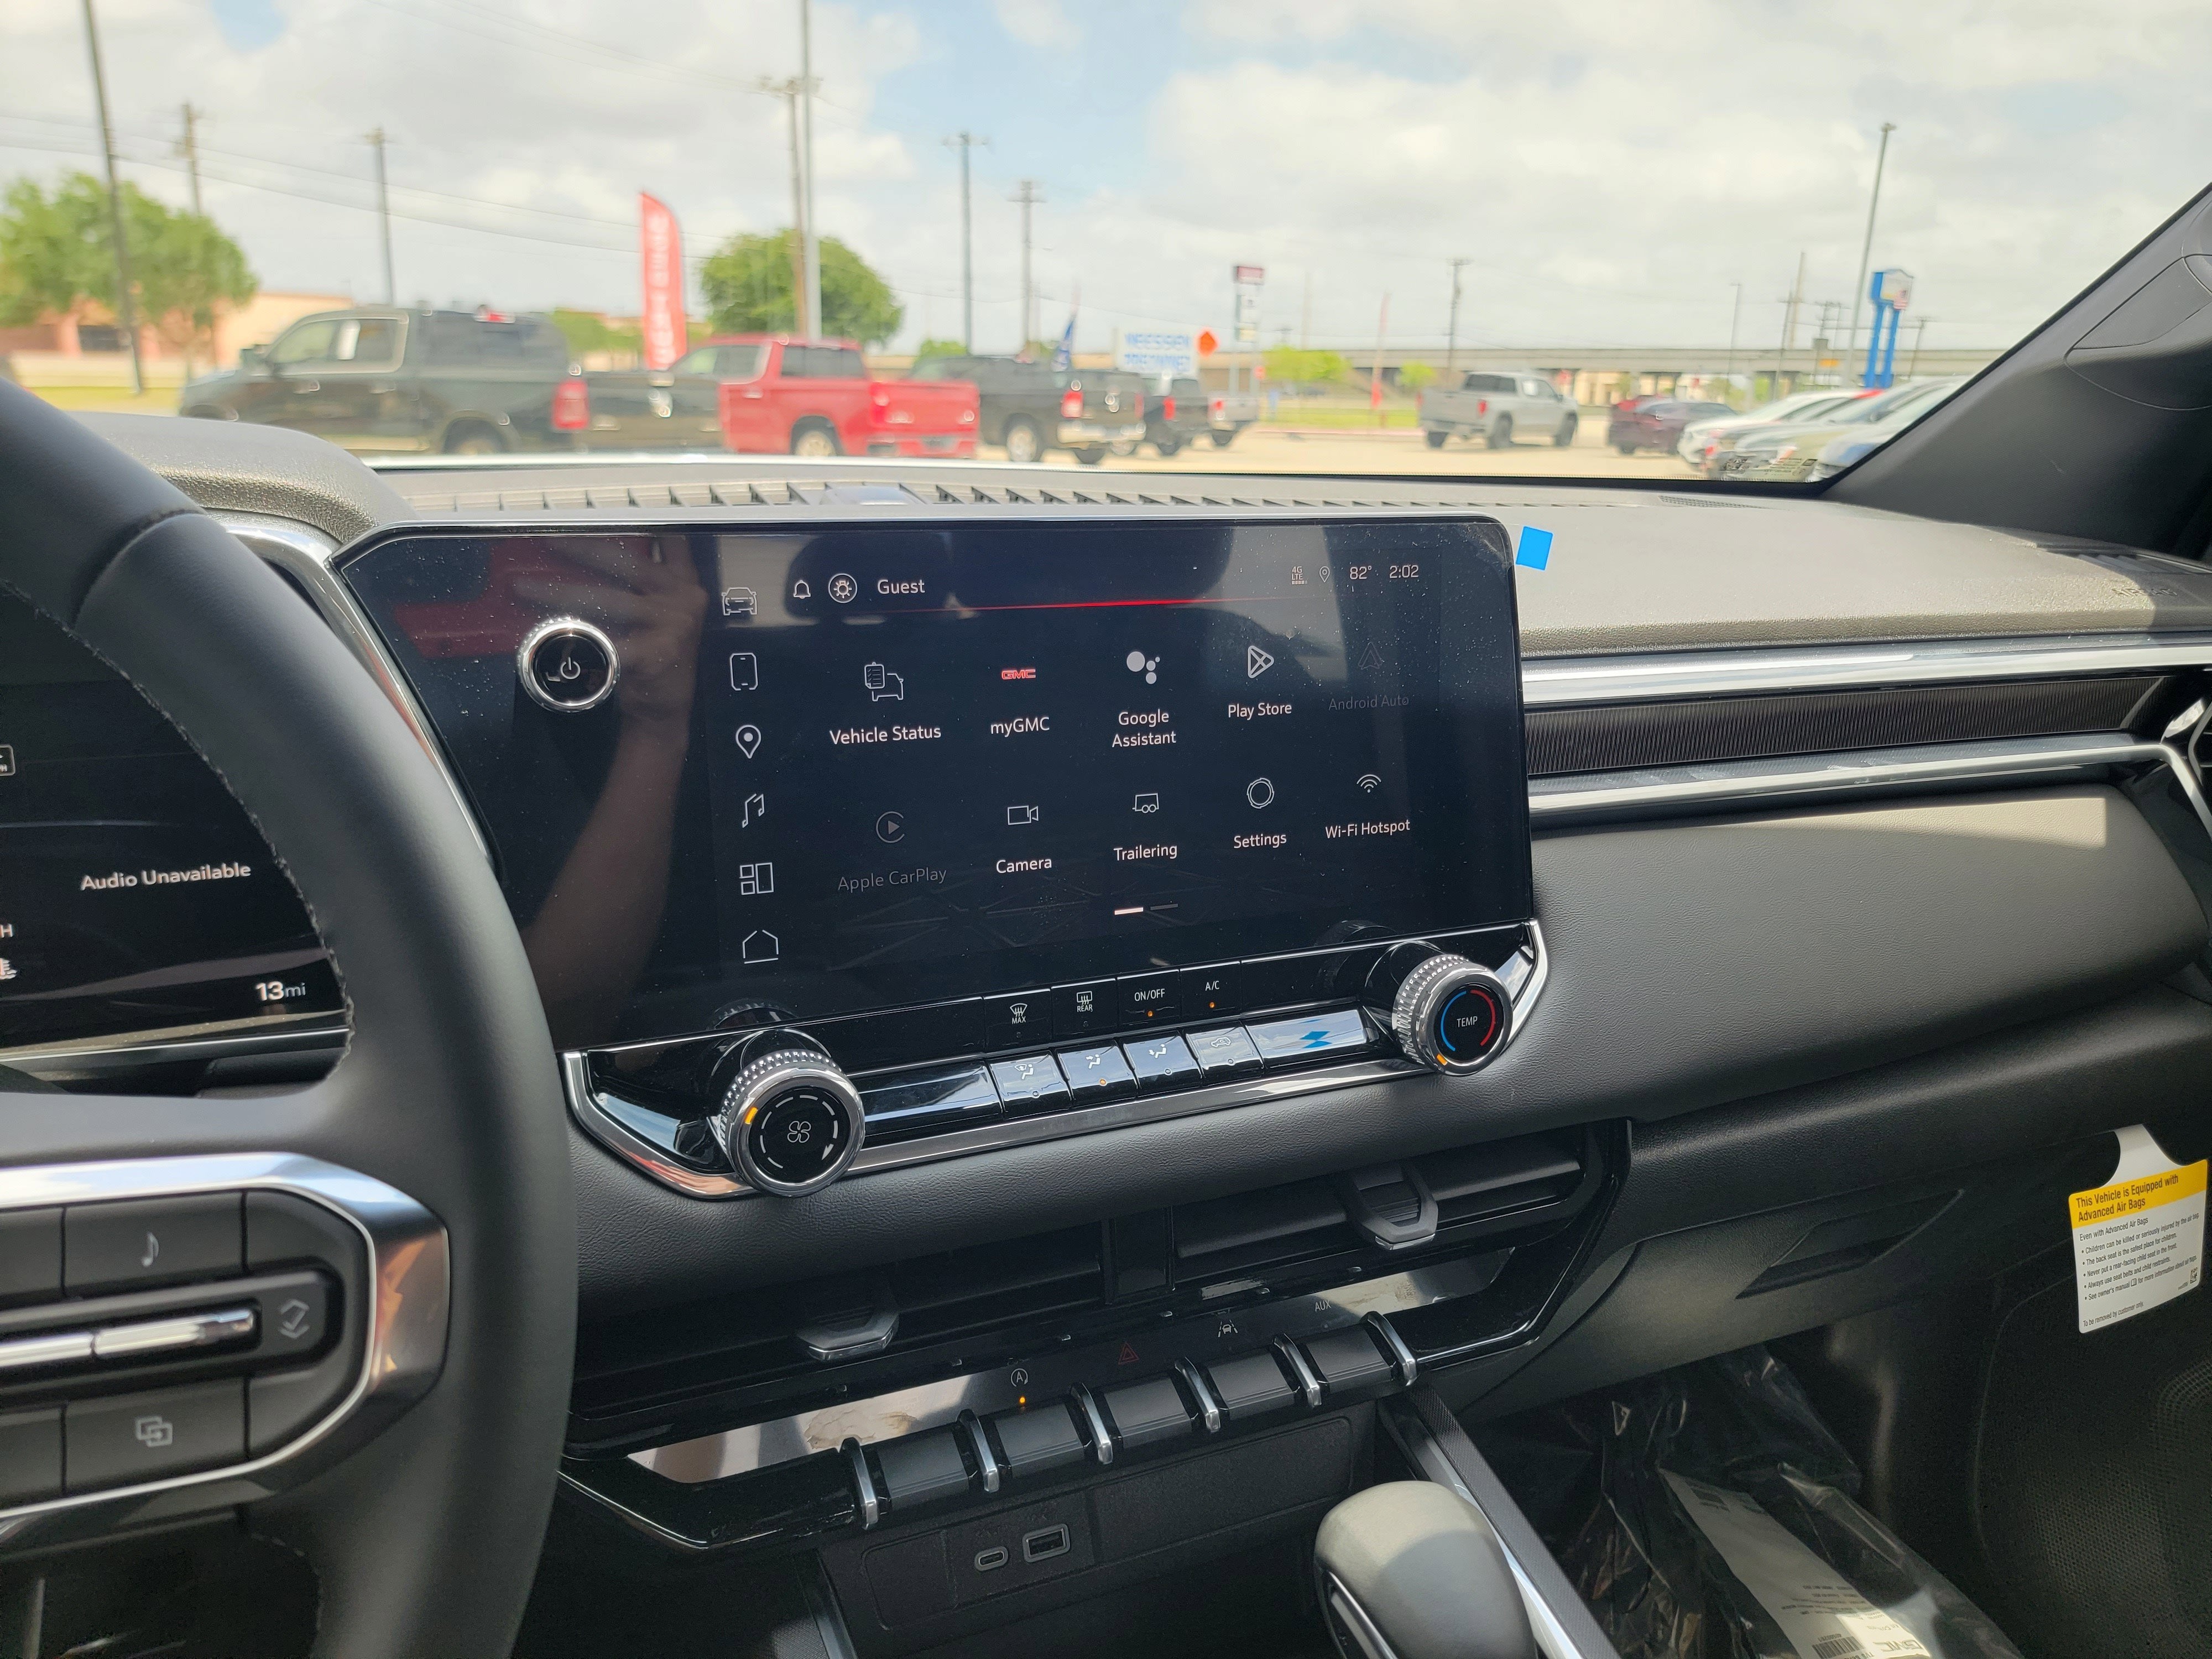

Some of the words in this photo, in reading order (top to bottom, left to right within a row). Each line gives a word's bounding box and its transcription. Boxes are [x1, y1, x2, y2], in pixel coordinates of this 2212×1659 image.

[1349, 565, 1372, 580] 82°
[1389, 565, 1419, 578] 2:02
[877, 579, 926, 595] Guest
[1001, 668, 1036, 680] GMC
[1328, 695, 1378, 711] Android
[1381, 694, 1410, 708] Auto
[1118, 708, 1170, 728] Google
[1227, 703, 1254, 721] Play
[1257, 702, 1292, 718] Store
[830, 728, 888, 746] Vehicle
[893, 724, 942, 742] Status
[990, 716, 1050, 738] myGMC
[1112, 730, 1177, 748] Assistant
[1325, 823, 1358, 839] Wi-Fi
[1361, 817, 1411, 836] Hotspot
[1233, 831, 1287, 849] Settings
[1114, 843, 1178, 862] Trailering
[996, 857, 1053, 874] Camera
[80, 873, 138, 891] Audio
[142, 862, 252, 885] Unavailable
[837, 872, 885, 892] Apple
[889, 867, 948, 886] CarPlay
[1205, 980, 1220, 992] A/C
[1134, 988, 1165, 1002] ON/OFF
[1077, 1003, 1093, 1013] REAR
[1011, 1015, 1027, 1024] MAX
[1457, 1015, 1478, 1027] TEMP
[2076, 1196, 2093, 1208] This
[2094, 1190, 2121, 1204] Vehicle
[2123, 1187, 2130, 1197] is
[2131, 1177, 2163, 1196] Equipped
[2164, 1173, 2179, 1187] with
[2078, 1204, 2115, 1222] Advanced
[2116, 1201, 2126, 1213] Air
[2128, 1198, 2146, 1209] Bags
[2079, 1233, 2092, 1241] Even
[2093, 1229, 2104, 1238] with
[2105, 1222, 2128, 1235] Advanced
[2137, 1217, 2148, 1226] Bags
[2085, 1244, 2105, 1254] Children
[2122, 1234, 2135, 1244] killed
[2141, 1227, 2160, 1239] seriously
[2096, 1254, 2106, 1263] back
[2107, 1251, 2117, 1260] seat
[2087, 1269, 2100, 1277] Never
[2088, 1279, 2104, 1289] Always
[2113, 1272, 2122, 1281] seat
[2133, 1266, 2142, 1275] and
[2098, 1287, 2115, 1297] owner's
[1314, 1300, 1332, 1312] AUX
[2095, 1312, 2112, 1324] removed
